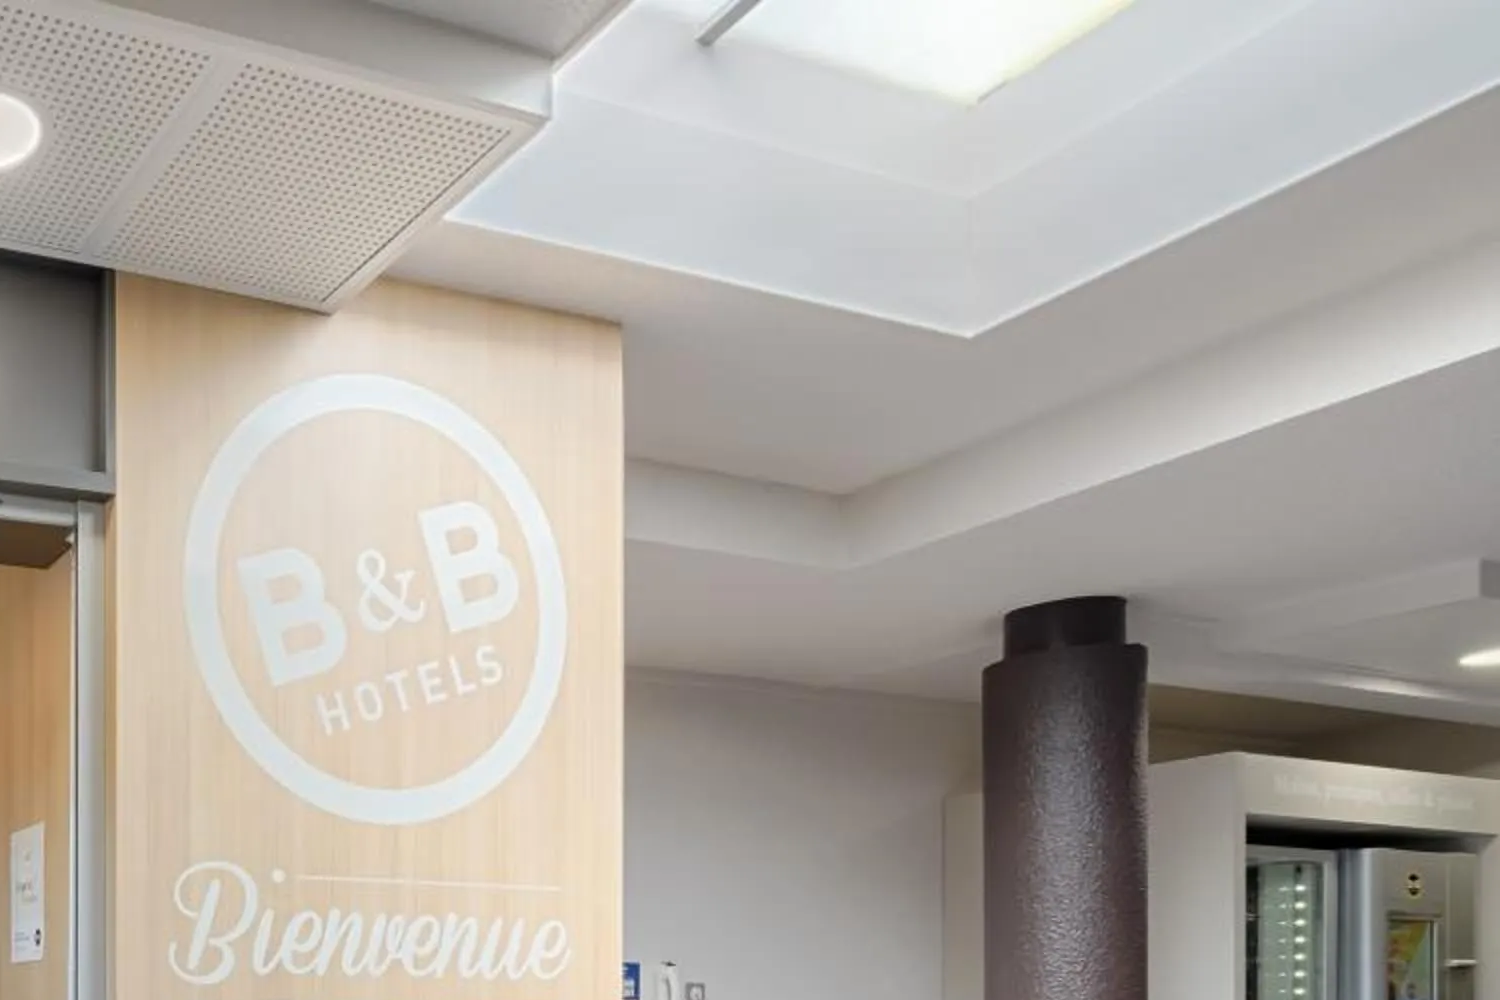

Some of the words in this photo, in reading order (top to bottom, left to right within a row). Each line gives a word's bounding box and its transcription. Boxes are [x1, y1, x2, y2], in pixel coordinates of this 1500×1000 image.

[236, 500, 520, 688] B&B
[315, 644, 505, 737] HOTELS
[168, 861, 573, 985] Bienvenue
